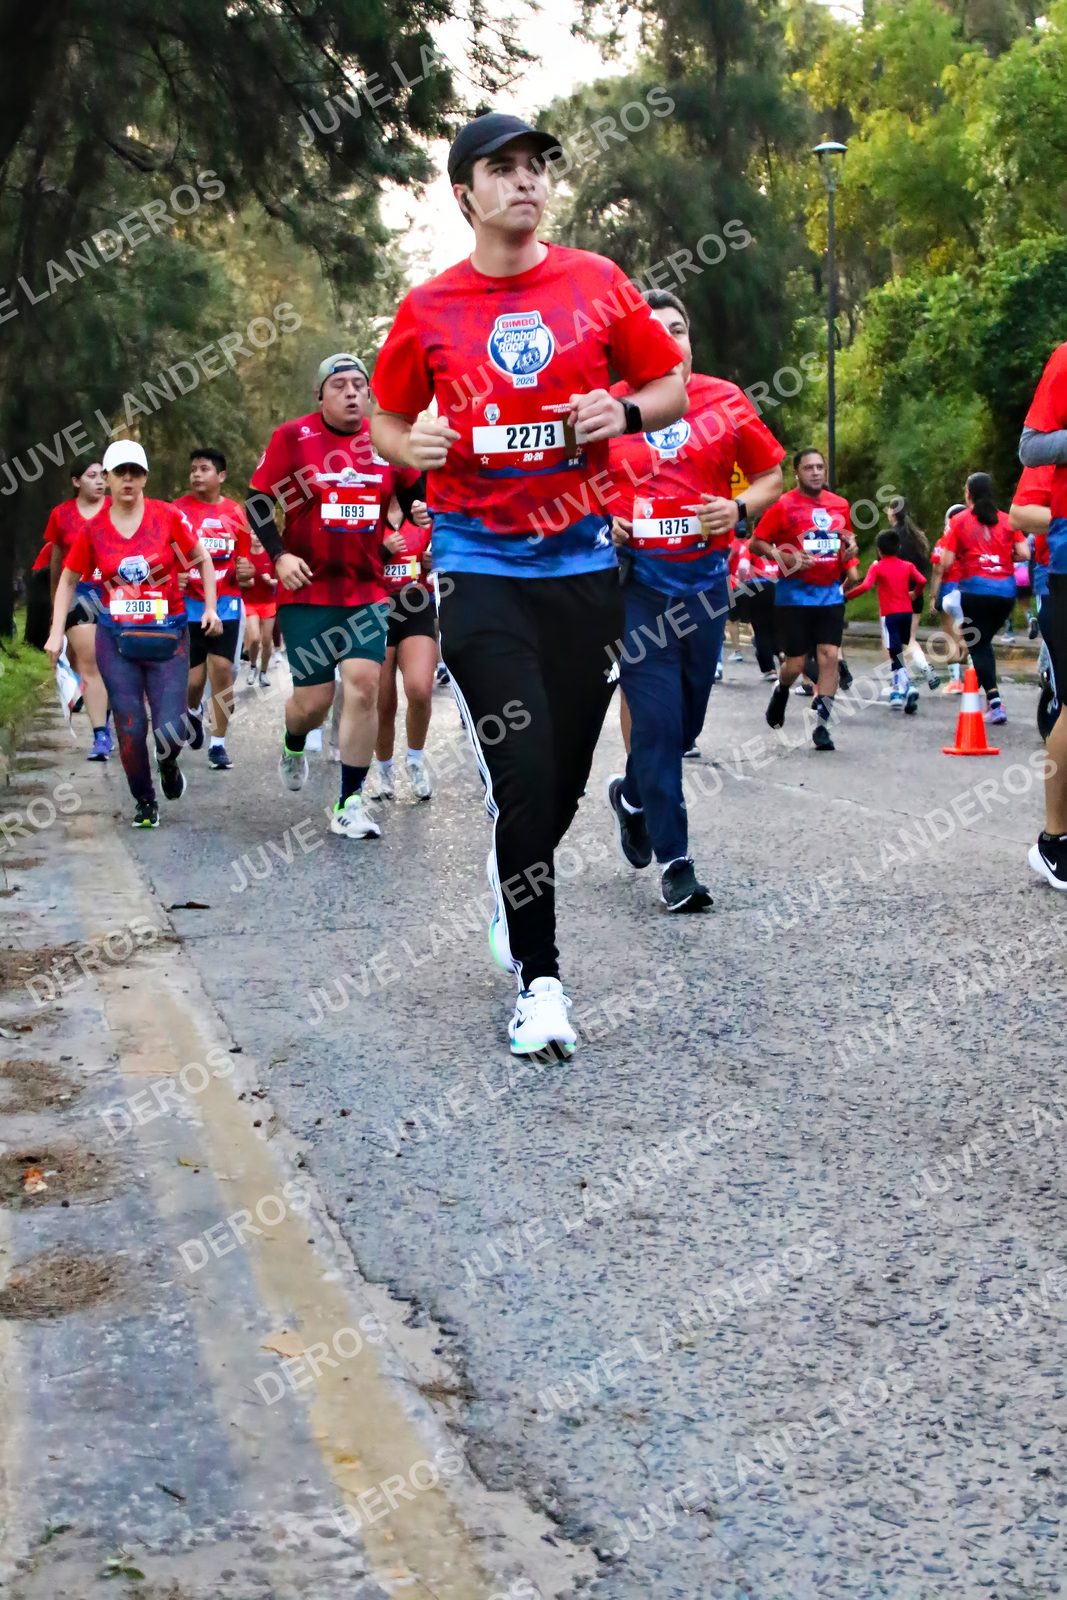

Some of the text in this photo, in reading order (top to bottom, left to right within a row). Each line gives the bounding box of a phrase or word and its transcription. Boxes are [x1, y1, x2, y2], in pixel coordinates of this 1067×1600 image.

[501, 317, 536, 328] BIMBO
[503, 329, 537, 343] Global
[498, 341, 525, 353] Race
[515, 376, 535, 386] 2026
[506, 424, 556, 449] 2273
[340, 505, 365, 518] 1693
[658, 519, 689, 535] 1375
[384, 564, 407, 576] 2213
[125, 600, 152, 613] 2303
